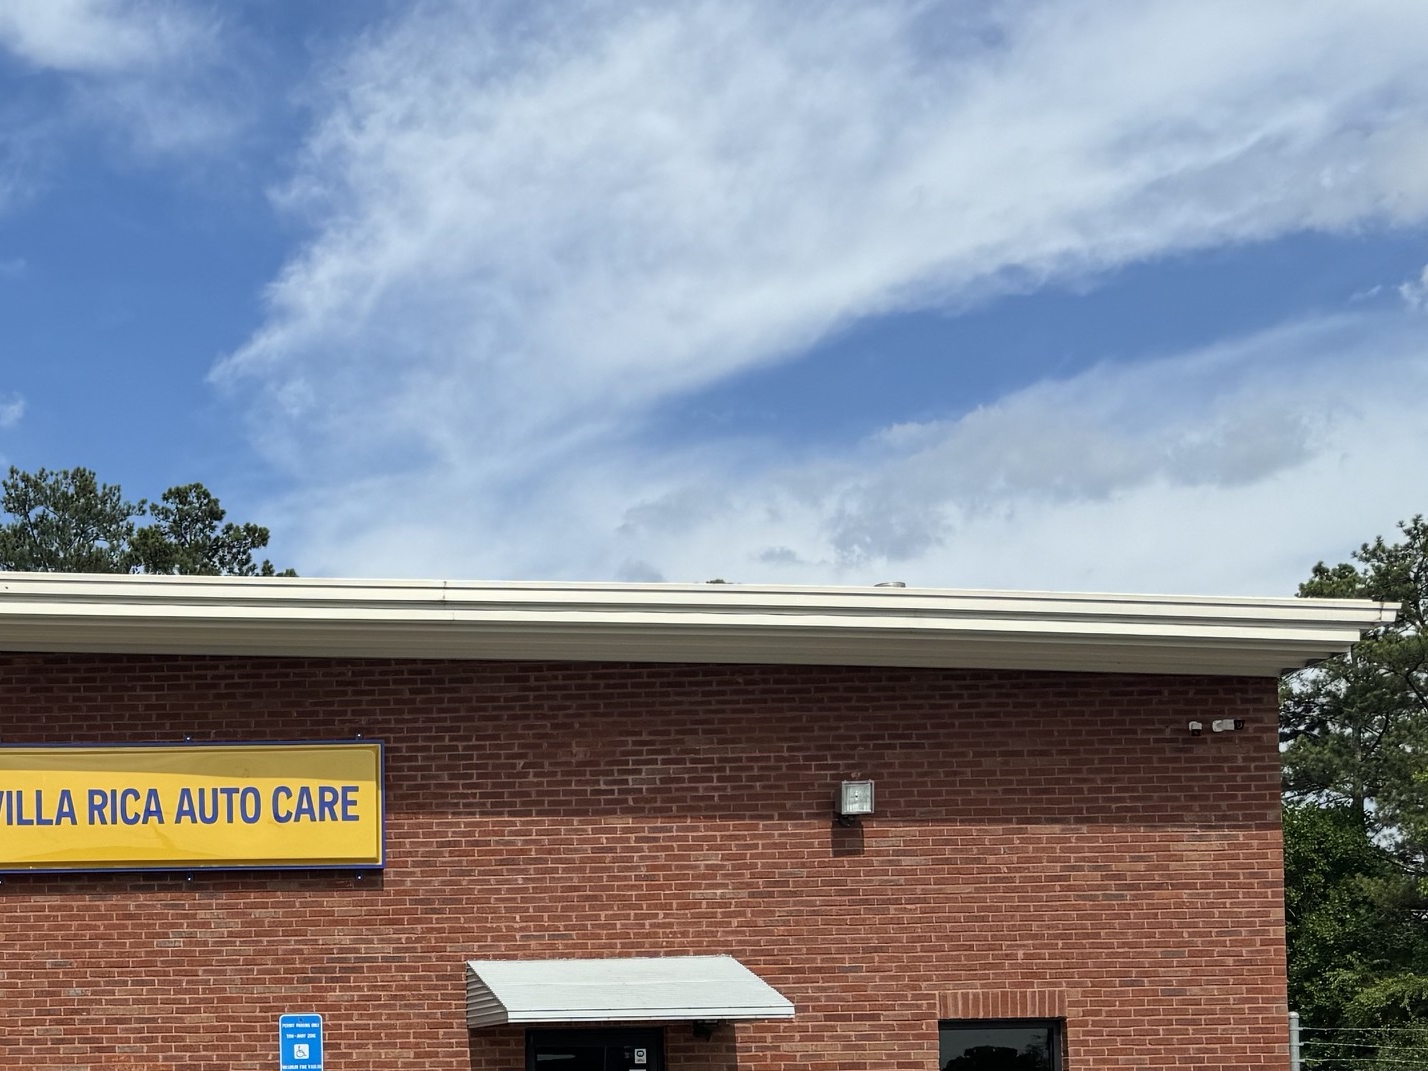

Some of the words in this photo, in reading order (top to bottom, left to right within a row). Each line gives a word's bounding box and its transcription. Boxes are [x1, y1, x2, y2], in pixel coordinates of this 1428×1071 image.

[88, 787, 165, 825] RICA
[174, 785, 262, 825] AUTO
[271, 785, 360, 824] CARE
